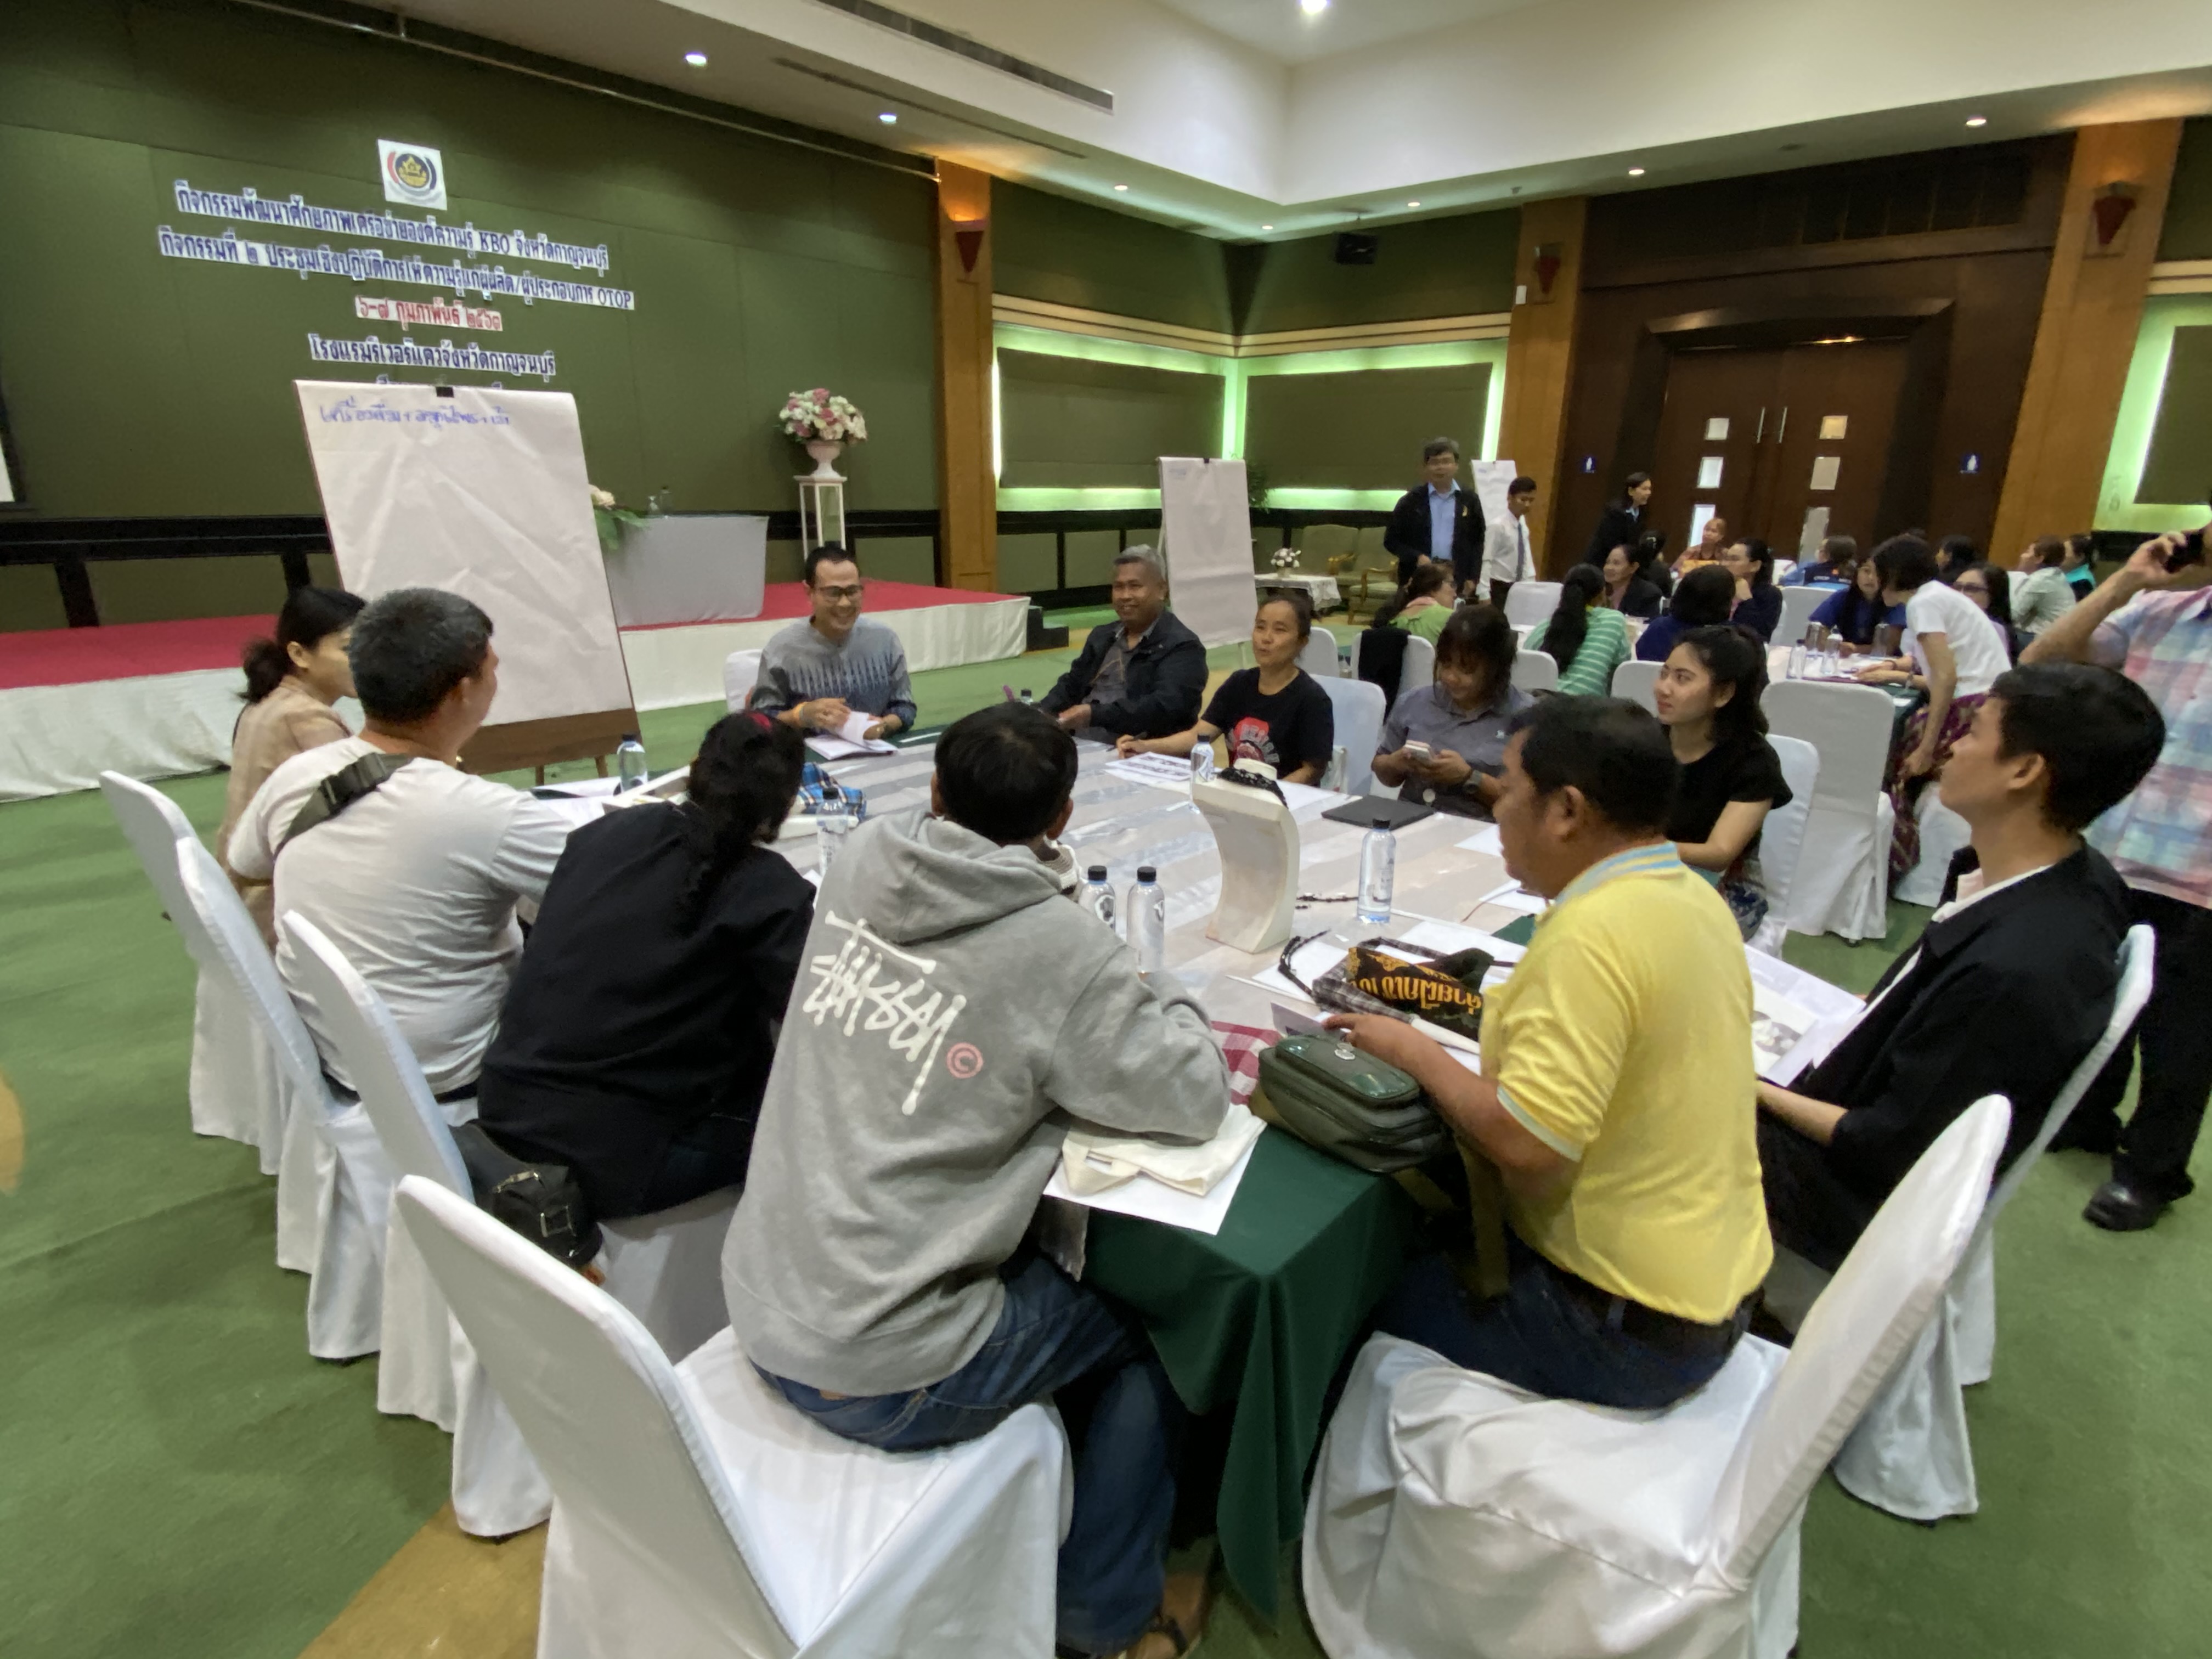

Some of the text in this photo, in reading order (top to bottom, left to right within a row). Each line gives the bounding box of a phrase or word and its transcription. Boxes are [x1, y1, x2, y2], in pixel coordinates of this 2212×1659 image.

[159, 225, 239, 262] กิจกรรมที่
[598, 287, 631, 308] OTOP
[479, 230, 510, 255] KBO
[514, 230, 608, 276] จังหวัดกาญจนบุรี
[396, 297, 462, 331] กุมภาพันธ์
